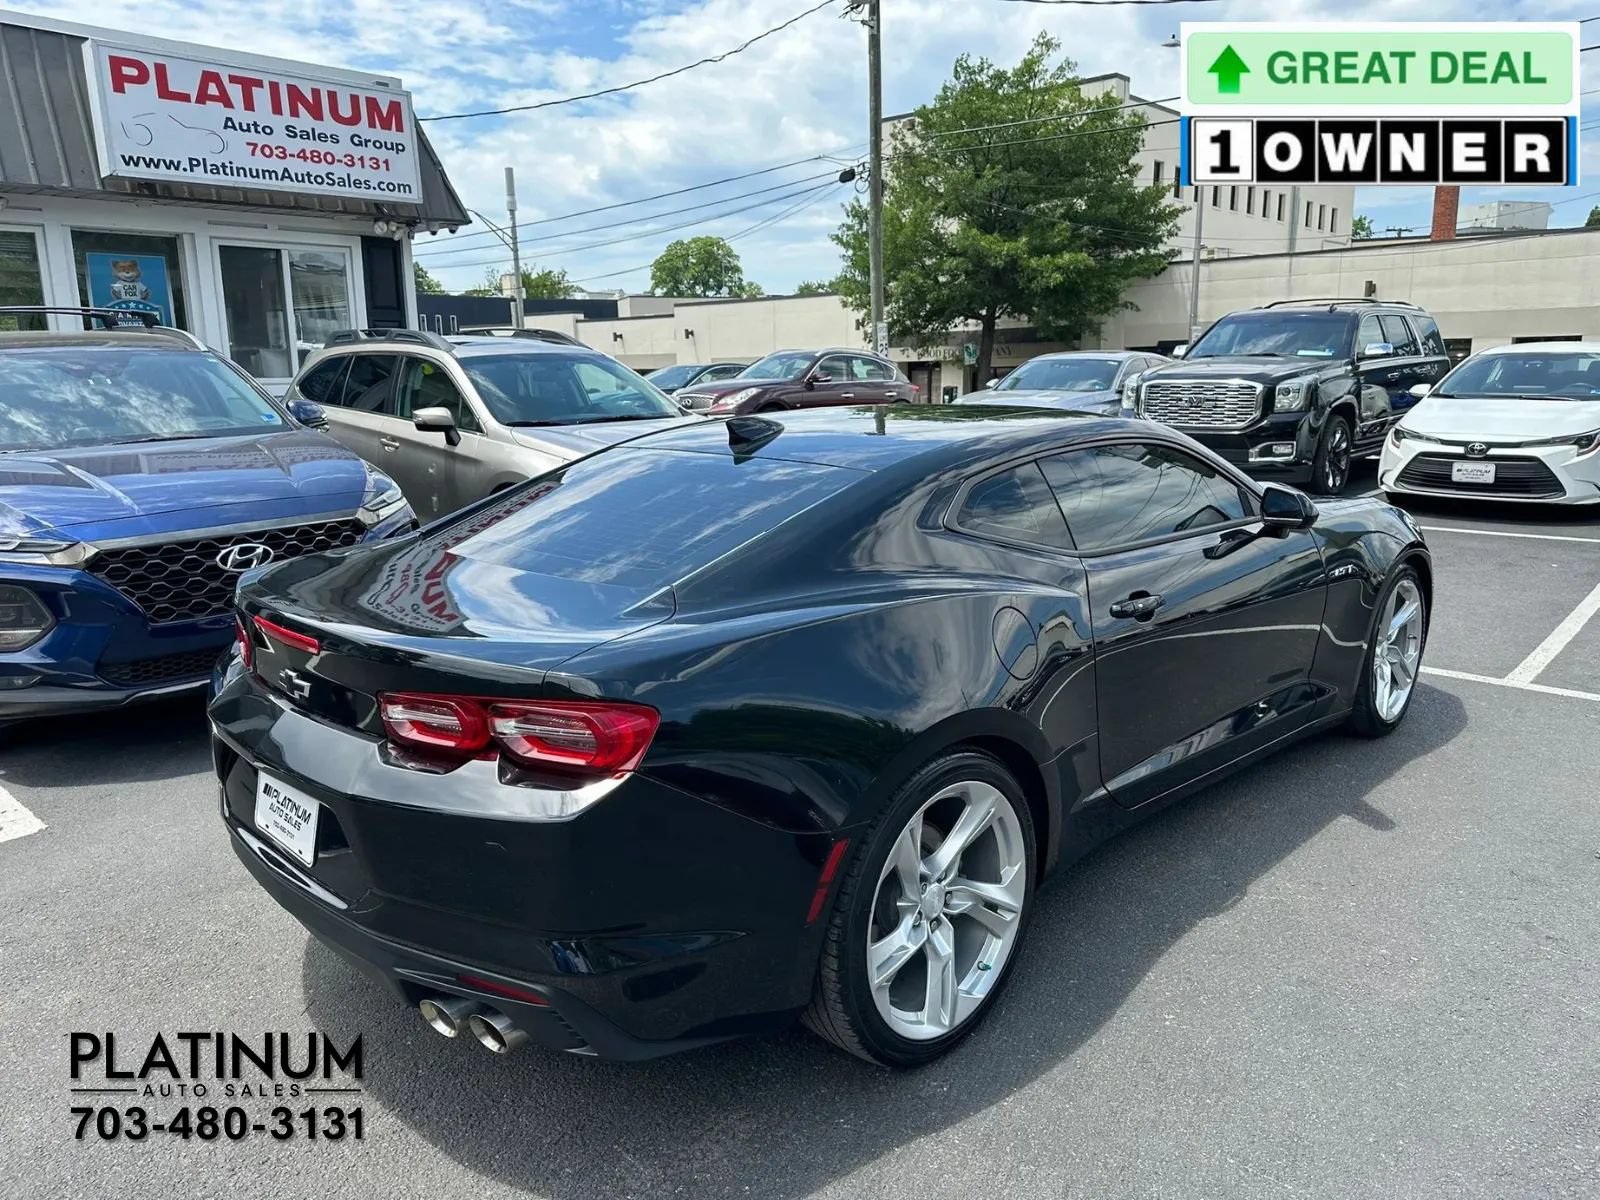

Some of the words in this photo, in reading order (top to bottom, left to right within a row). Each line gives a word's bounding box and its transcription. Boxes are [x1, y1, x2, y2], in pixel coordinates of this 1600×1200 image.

[108, 55, 404, 133] PLATINUM
[223, 116, 274, 136] Auto
[285, 124, 340, 144] Sales
[350, 133, 406, 154] Group
[120, 154, 412, 194] www.PlatinumAutoSales.com
[246, 142, 391, 172] 703-480-3131
[268, 802, 284, 818] AUTO
[283, 812, 303, 832] SALES
[272, 788, 312, 825] PLATINUM
